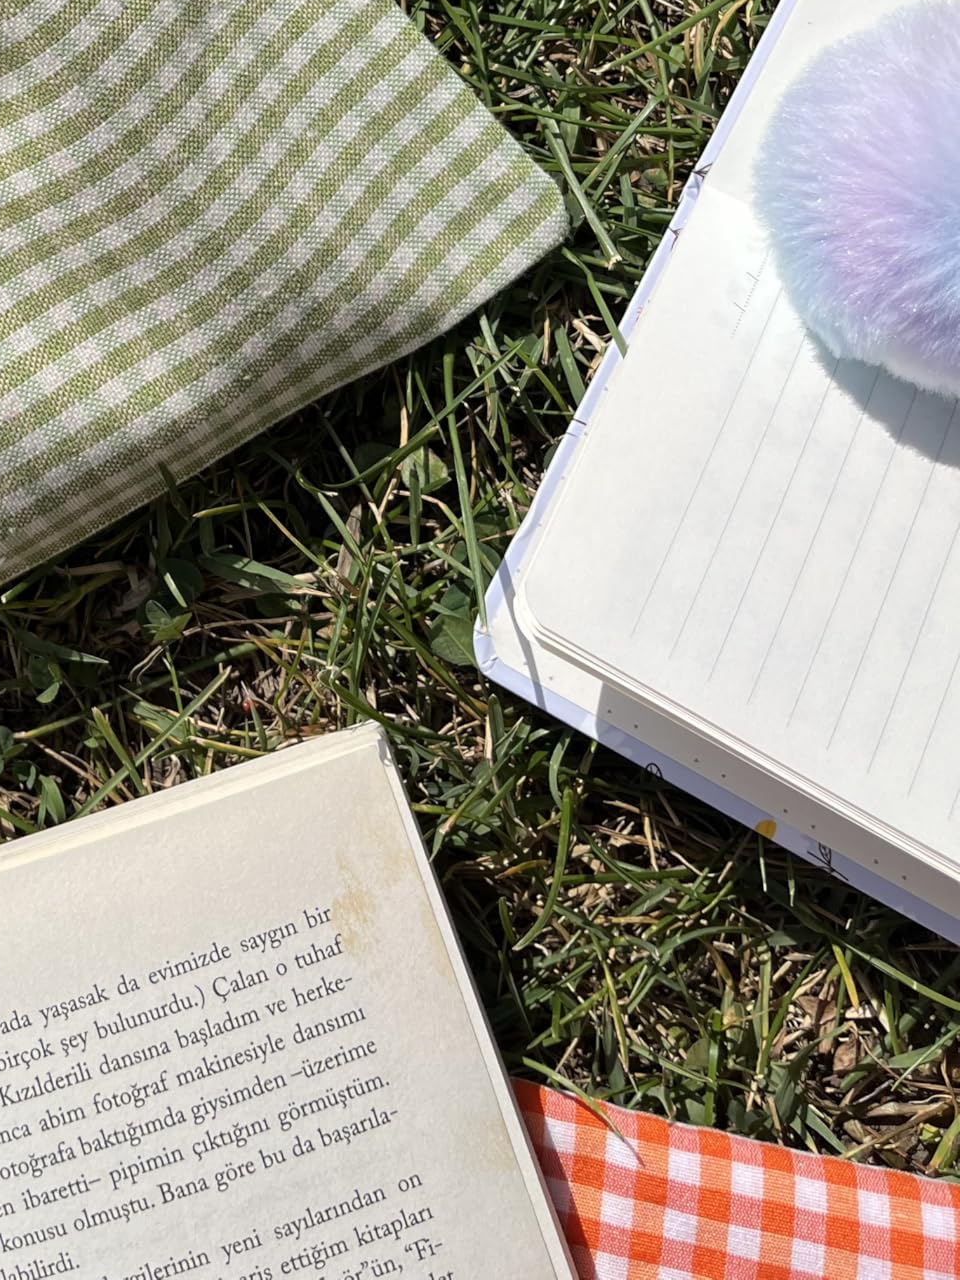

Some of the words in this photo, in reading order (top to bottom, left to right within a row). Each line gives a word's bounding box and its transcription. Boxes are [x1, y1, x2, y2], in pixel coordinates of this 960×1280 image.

[38, 983, 111, 1029] yaşasak
[116, 973, 141, 996] da
[148, 941, 232, 985] evimizde
[239, 922, 299, 954] saygın
[302, 906, 332, 929] bir
[59, 1030, 89, 1058] şey
[92, 984, 206, 1040] bulunurdu.)
[212, 969, 270, 1004] Çalan
[275, 962, 288, 977] o
[293, 932, 344, 970] tuhaf
[99, 1040, 172, 1076] dansına
[173, 1009, 261, 1049] başladım
[264, 999, 288, 1017] ve
[290, 975, 353, 1008] herke-
[38, 1106, 87, 1133] abim
[92, 1069, 169, 1115] fotoğraf
[175, 1033, 286, 1088] makinesiyle
[292, 1007, 367, 1045] dansımı
[77, 1105, 188, 1157] baktığımda
[190, 1074, 288, 1126] giysimden
[73, 1197, 156, 1232] olmuştu.
[156, 1177, 211, 1205] Bana
[214, 1160, 257, 1193] göre
[258, 1148, 288, 1169] bu
[291, 1134, 316, 1158] da
[316, 1106, 399, 1148] başarıla-
[108, 1146, 185, 1192] pipimin
[192, 1117, 272, 1162] çıktığını
[277, 1075, 390, 1133] görmüştüm.
[220, 1228, 263, 1266] yeni
[273, 1188, 387, 1241] sayılarından
[397, 1174, 424, 1193] on
[280, 1239, 350, 1275] ettiğim
[352, 1207, 435, 1248] kitapları
